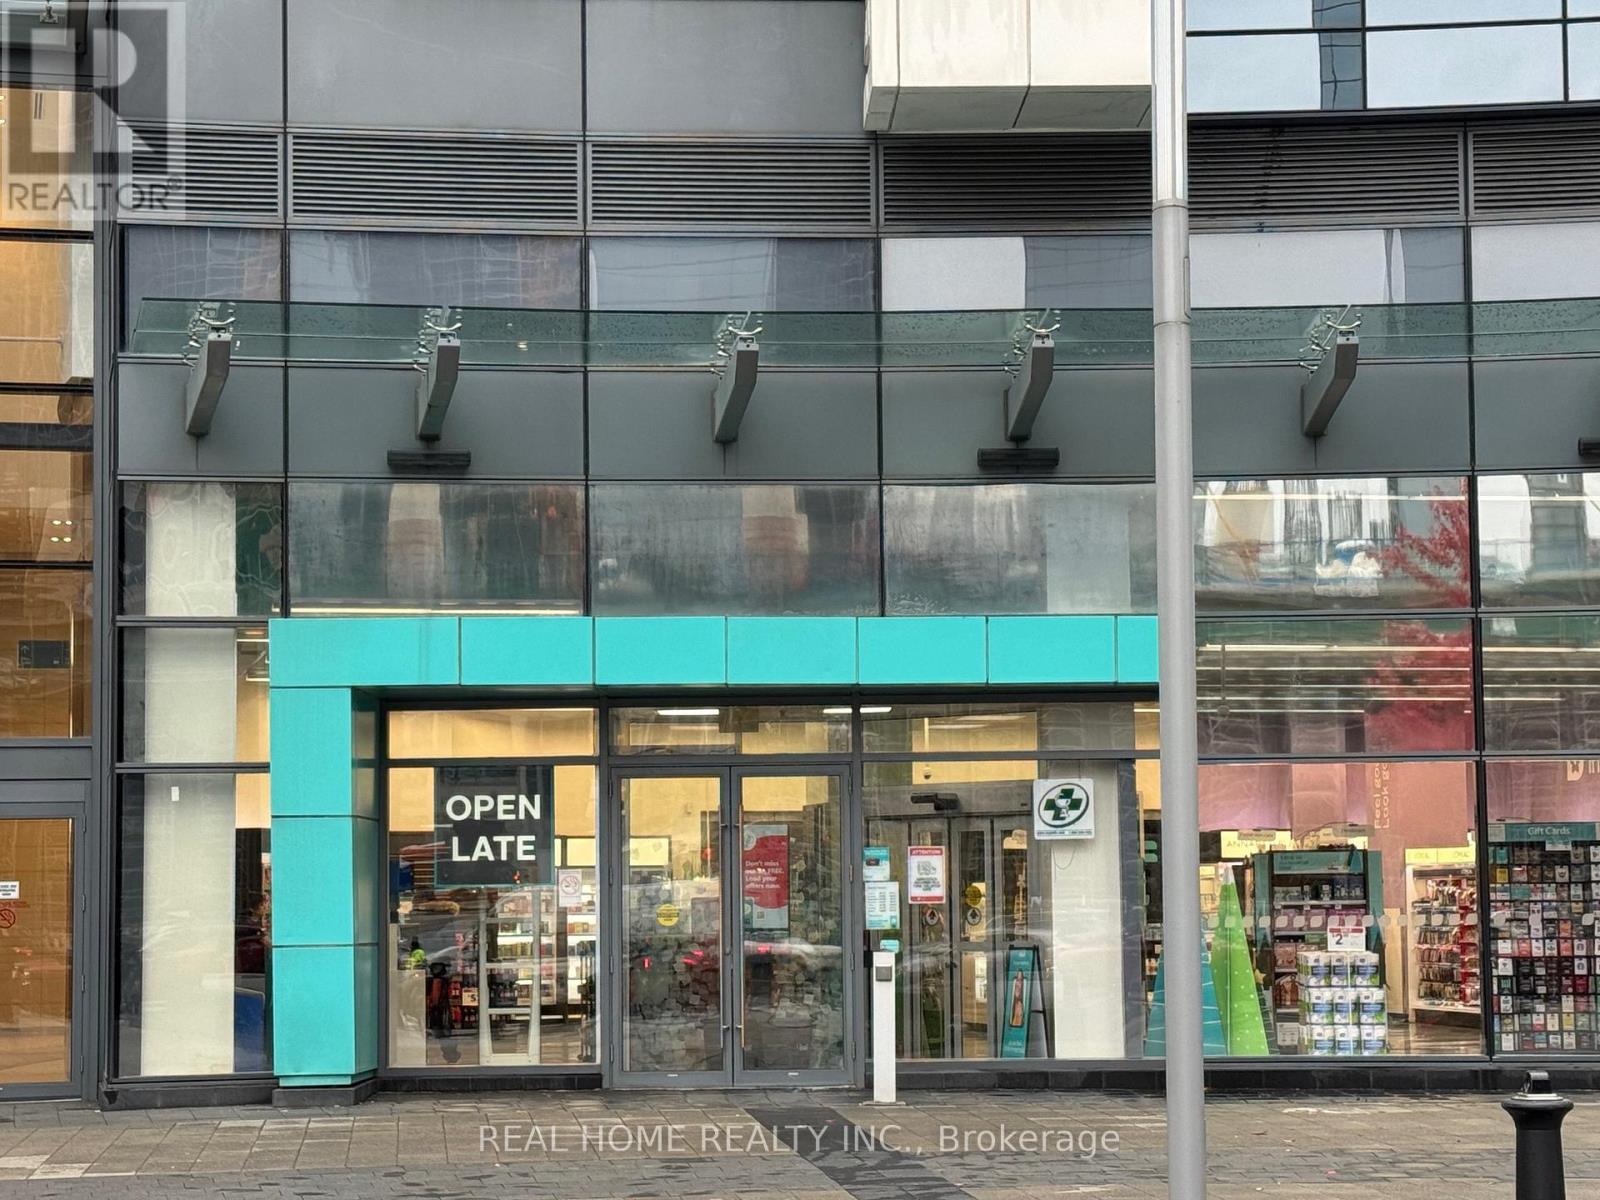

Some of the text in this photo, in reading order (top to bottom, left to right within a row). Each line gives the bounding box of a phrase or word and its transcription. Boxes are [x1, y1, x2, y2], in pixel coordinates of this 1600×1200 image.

[446, 794, 541, 821] OPEN
[1528, 825, 1570, 836] Gift Cards
[452, 835, 536, 862] LATE
